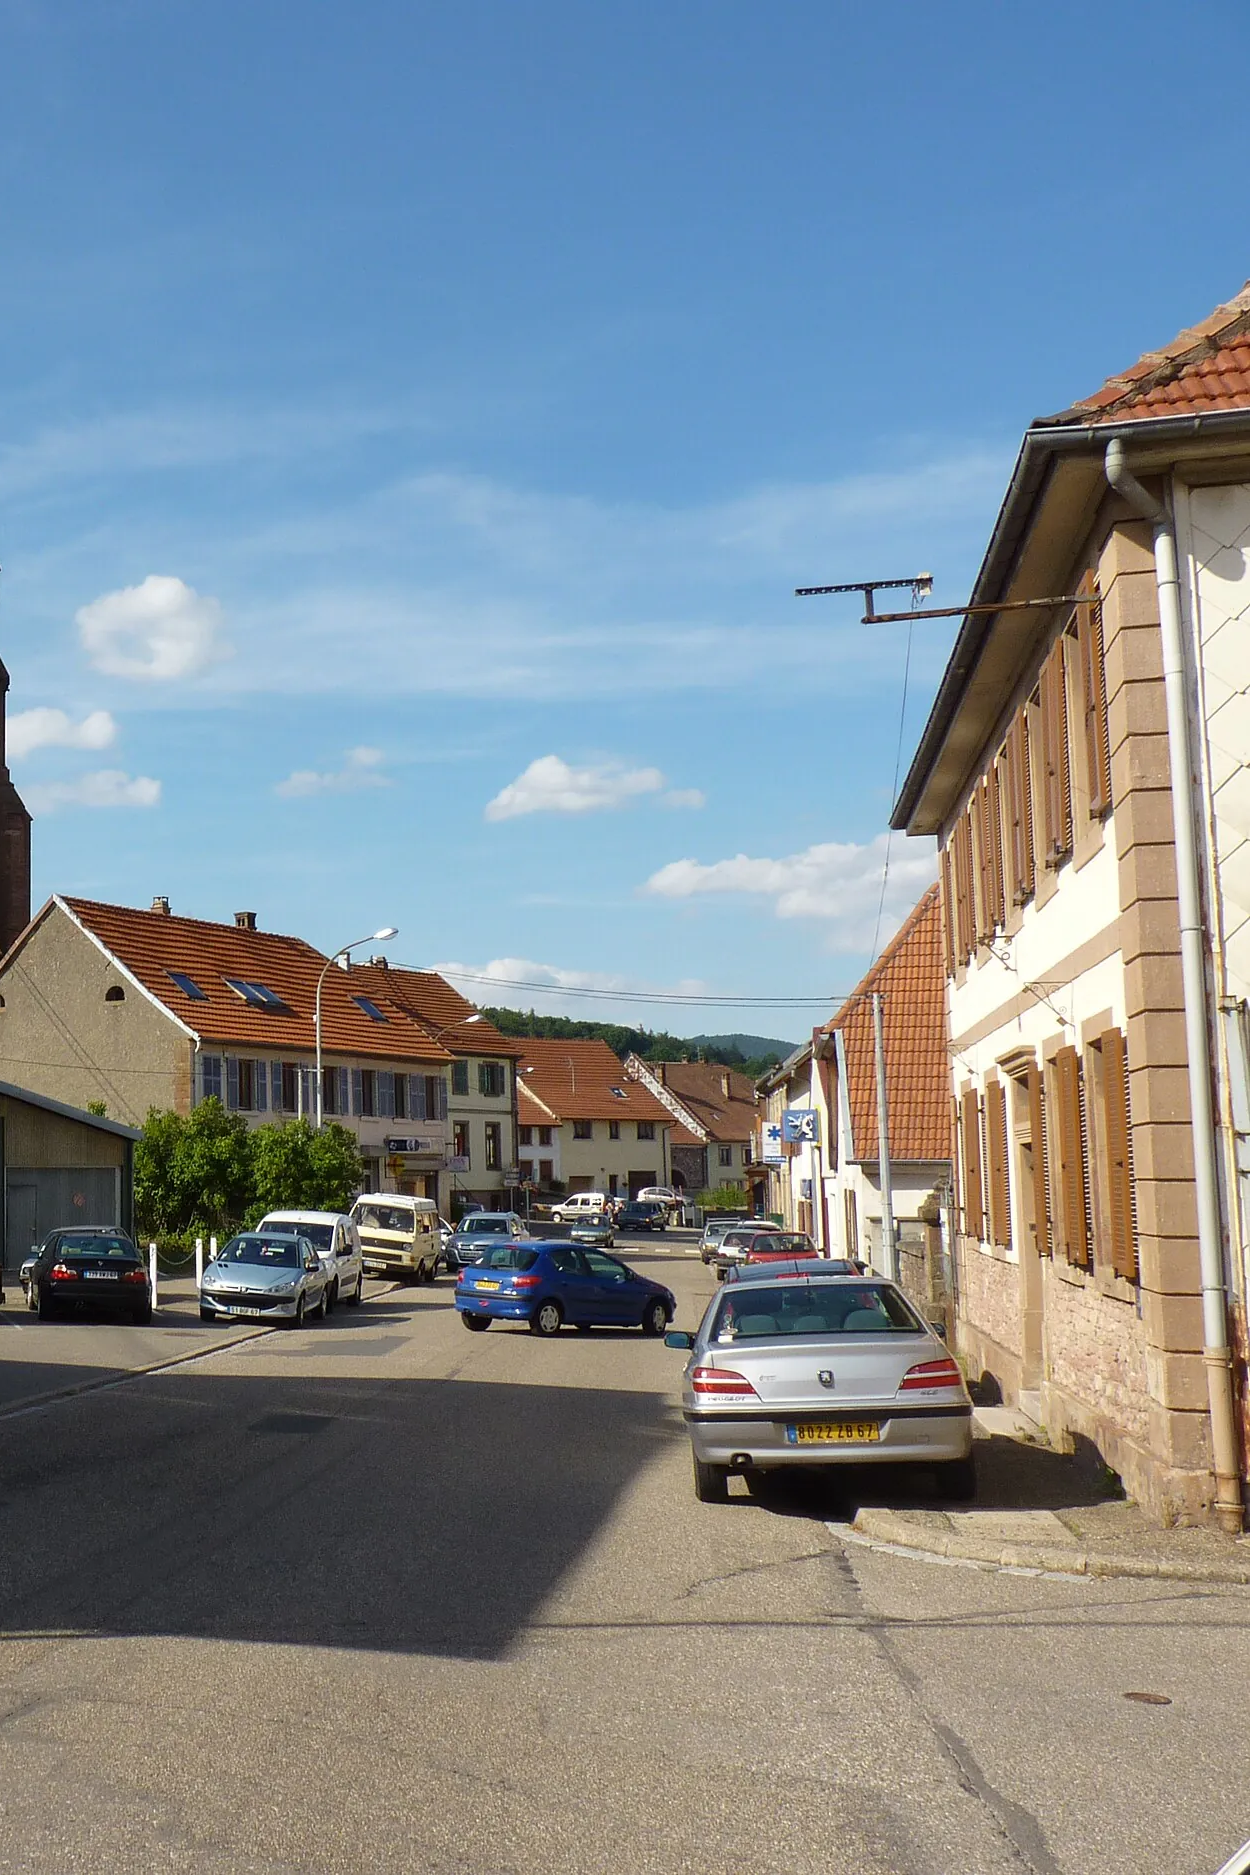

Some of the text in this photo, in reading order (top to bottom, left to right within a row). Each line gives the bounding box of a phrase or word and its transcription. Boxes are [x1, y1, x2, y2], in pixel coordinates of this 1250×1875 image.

[798, 1423, 873, 1439] 8022 ZB 67
